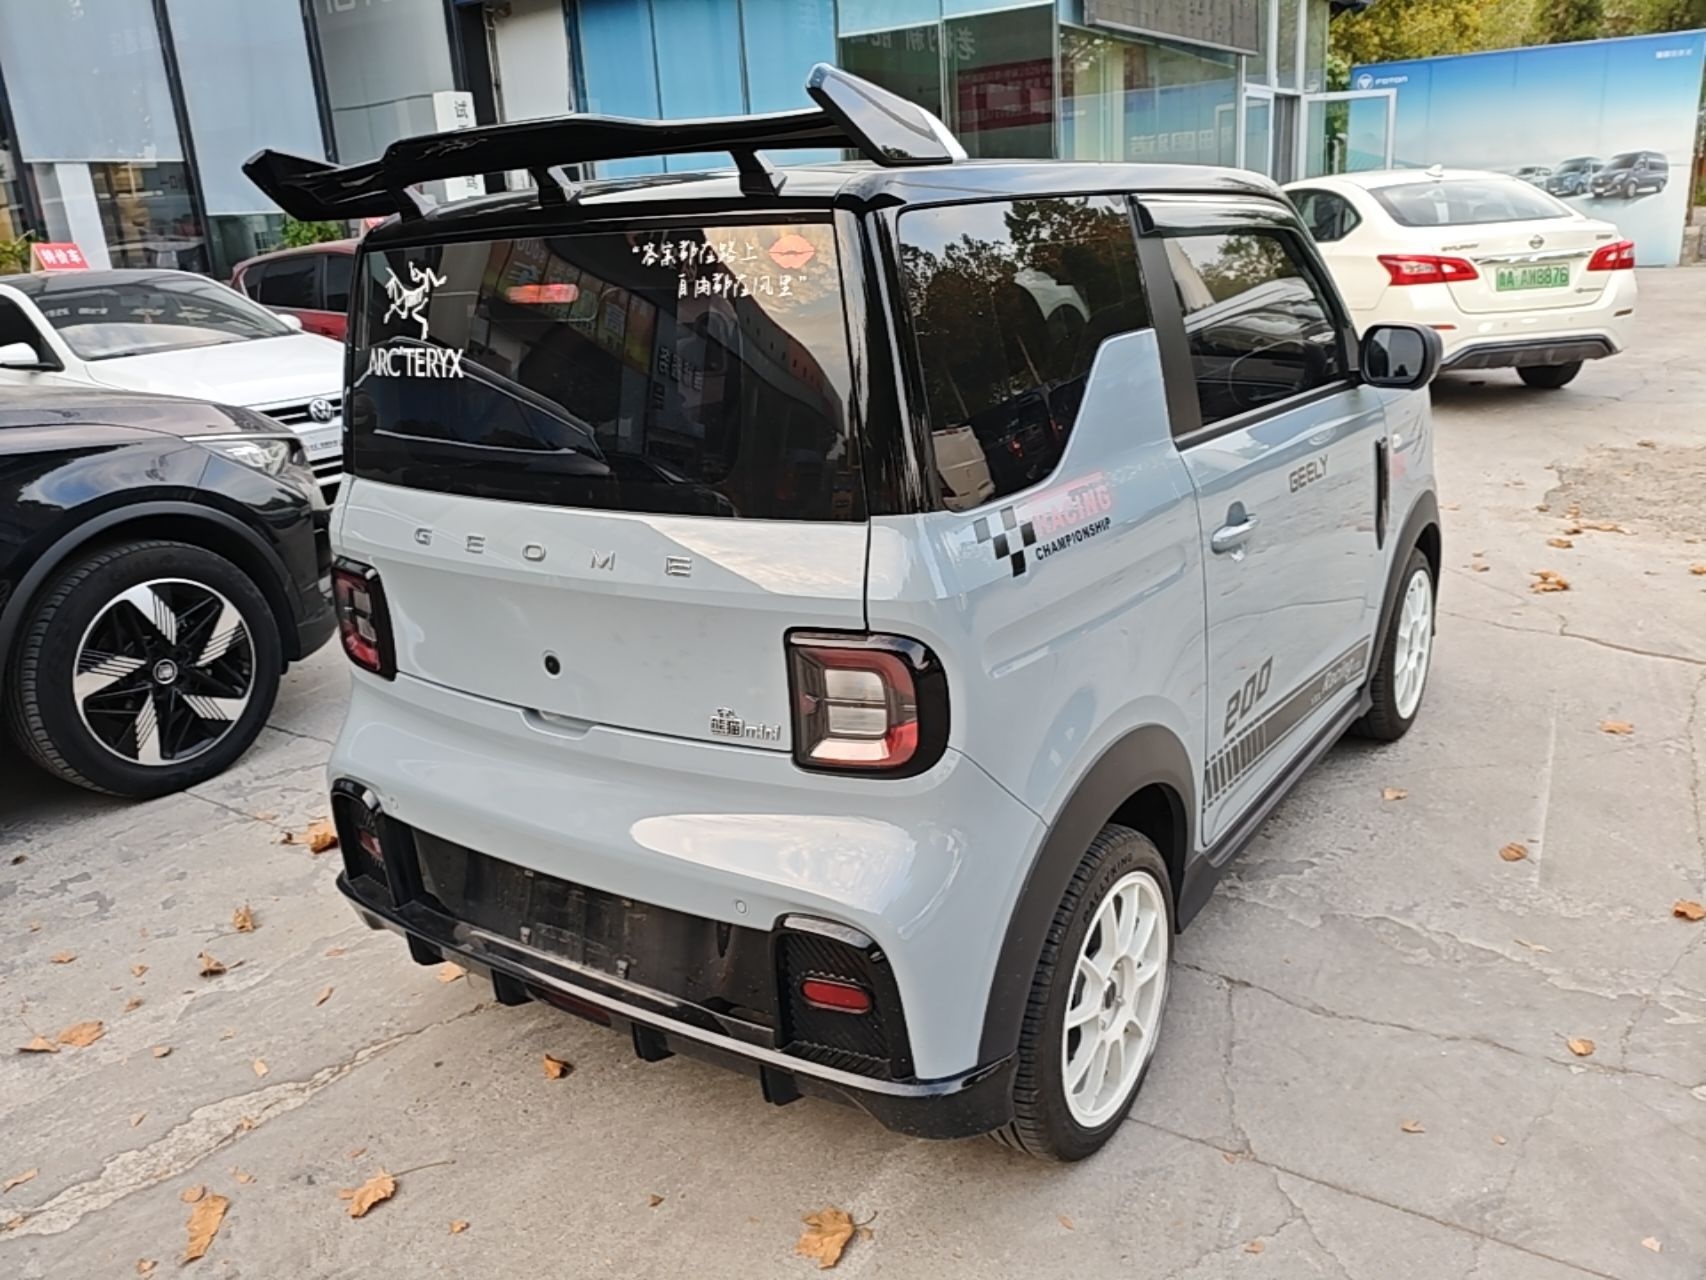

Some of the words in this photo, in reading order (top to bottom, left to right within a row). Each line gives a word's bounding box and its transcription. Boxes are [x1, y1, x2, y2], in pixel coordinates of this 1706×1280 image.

[1289, 454, 1329, 494] GEELY
[414, 527, 693, 578] GEOME
[1035, 517, 1112, 561] CHAMPIONSHIP
[1223, 656, 1273, 739] 200
